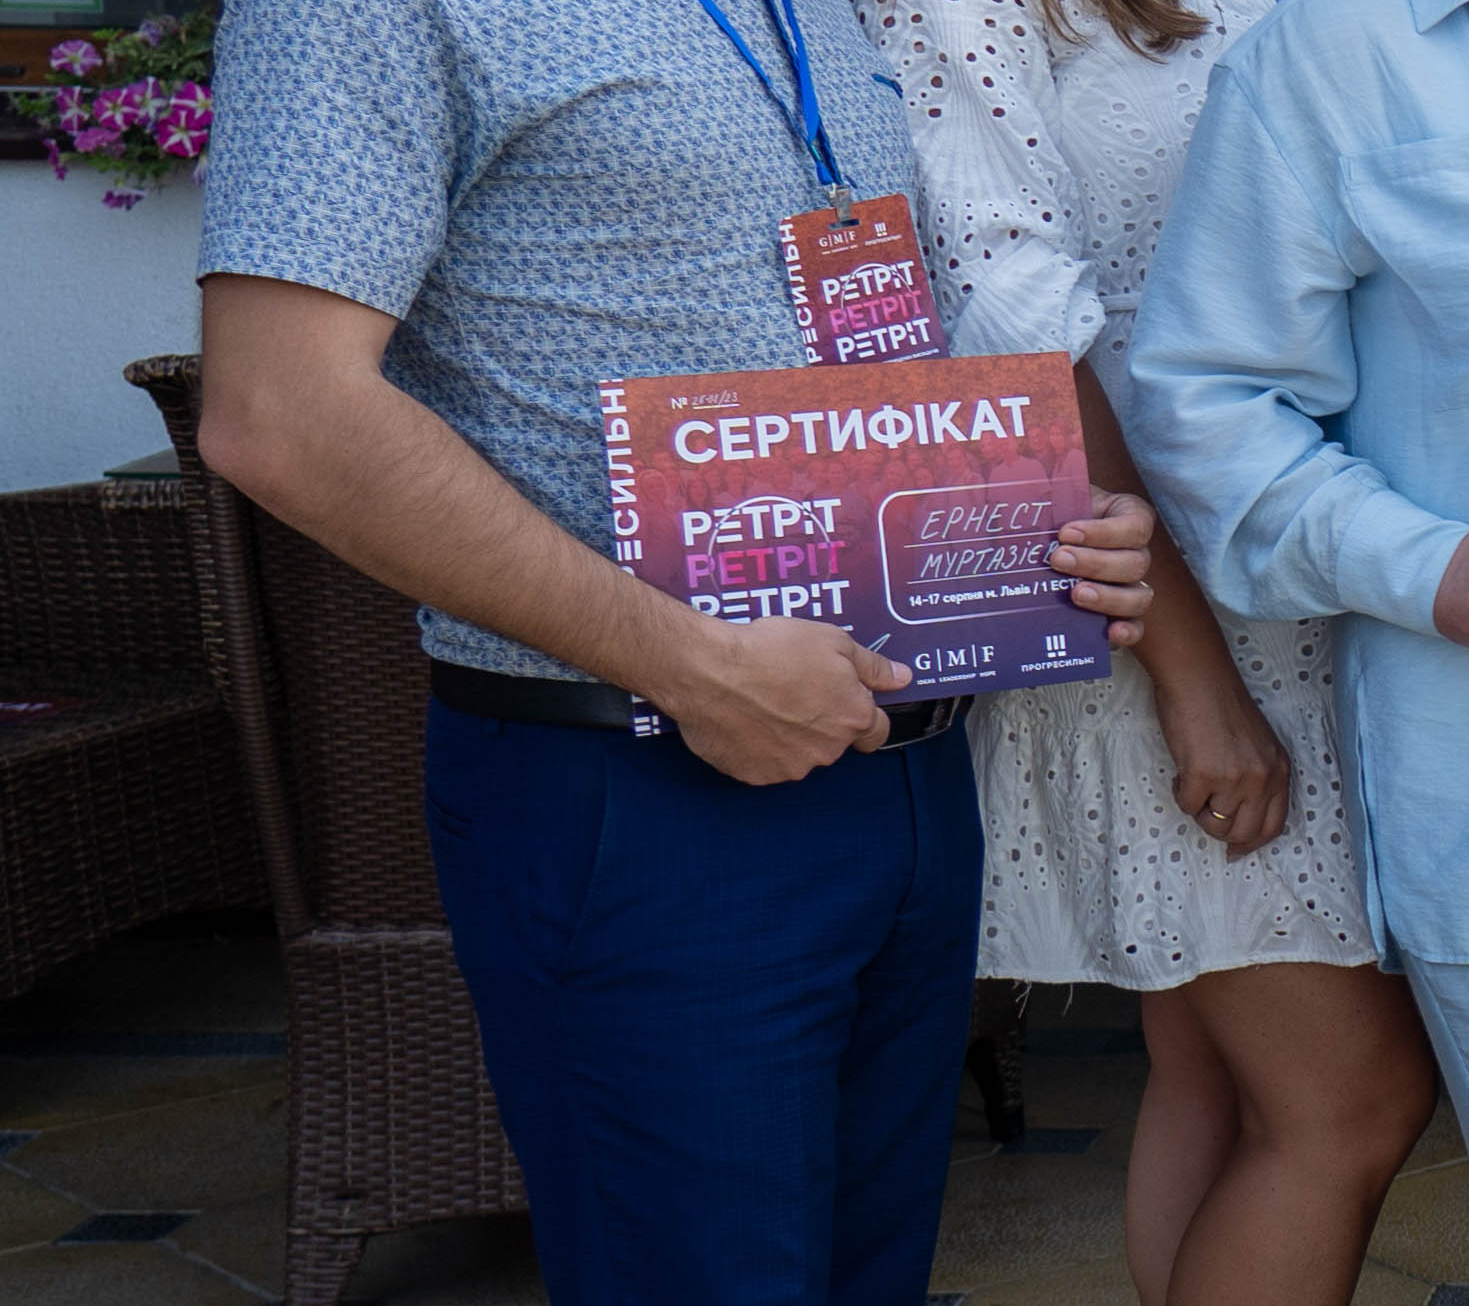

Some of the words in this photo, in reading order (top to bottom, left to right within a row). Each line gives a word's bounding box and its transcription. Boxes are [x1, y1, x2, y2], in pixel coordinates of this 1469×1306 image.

[674, 396, 1031, 463] СЕРТИФІКАТ
[920, 502, 1052, 540] ЕРНЕСТ
[1000, 585, 1031, 597] Львів
